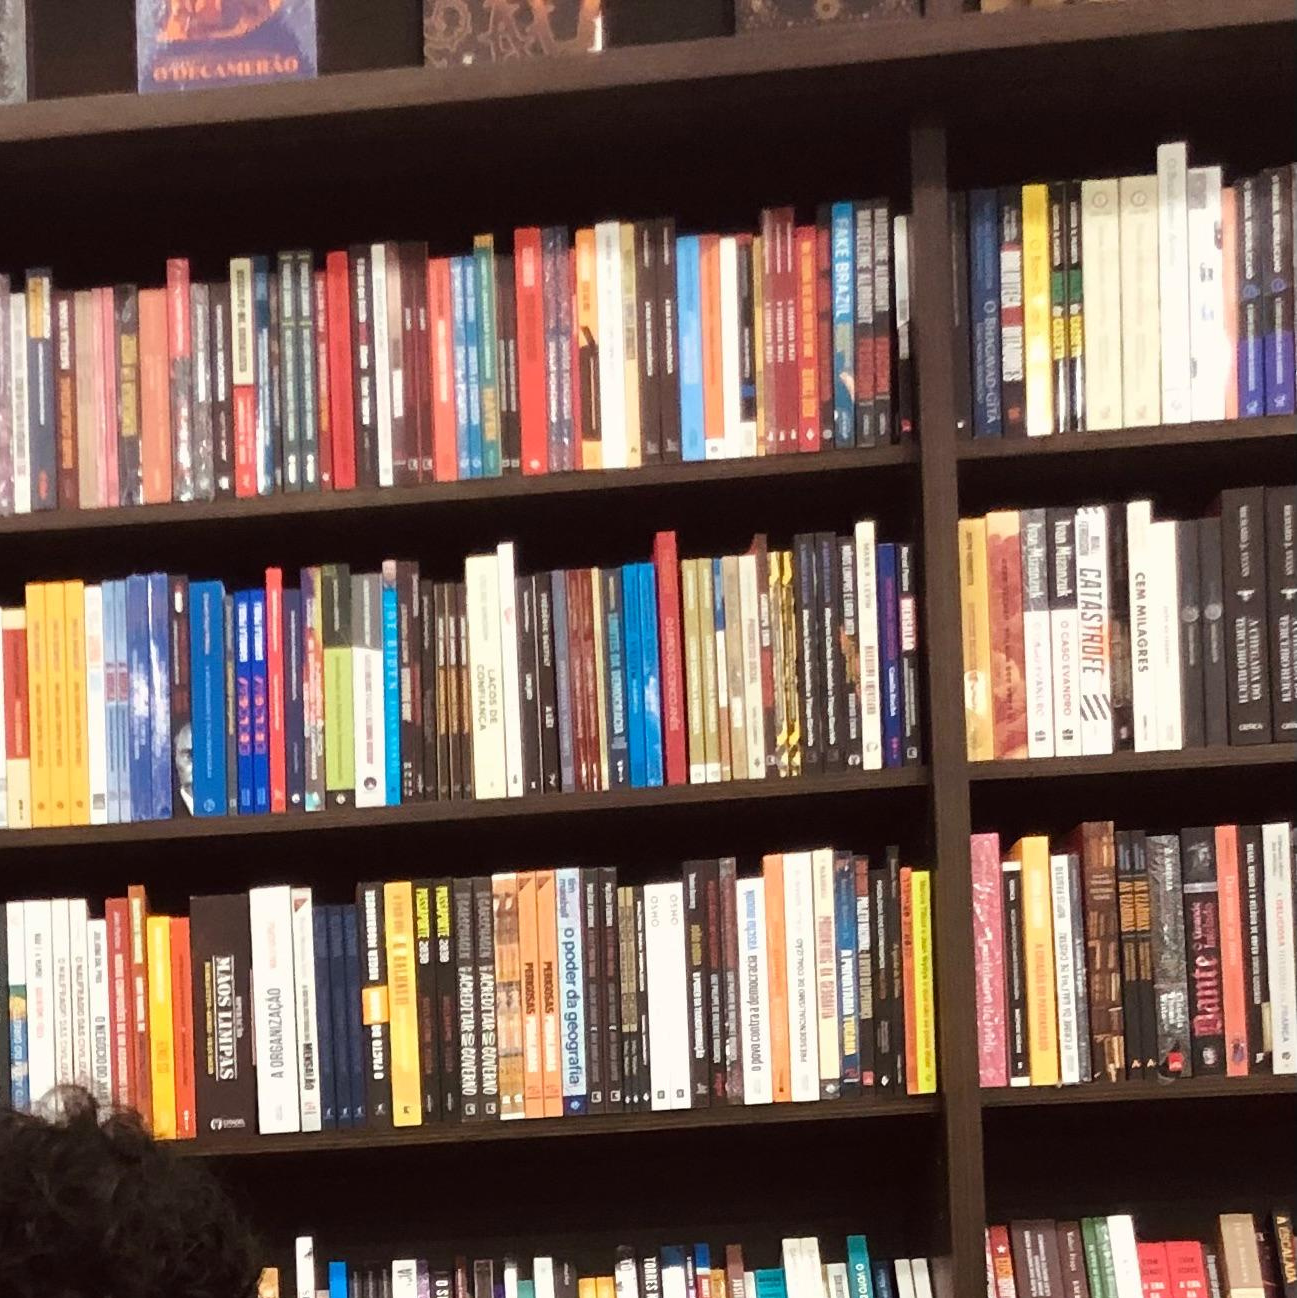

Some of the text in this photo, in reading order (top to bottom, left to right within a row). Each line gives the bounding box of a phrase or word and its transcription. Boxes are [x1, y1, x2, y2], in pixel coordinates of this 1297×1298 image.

[835, 217, 852, 318] FAKE BRAZIL
[1055, 520, 1070, 543] Ivan
[1079, 568, 1105, 674] CATÁSTROFE
[1135, 573, 1148, 673] CEM MILAGRES
[1061, 631, 1072, 716] CASO EVANDRO
[266, 988, 285, 1067] ORGANIZAÇÃO
[525, 963, 534, 1014] PERIGOSAS
[543, 961, 553, 1013] PERIGOSAS
[562, 927, 583, 1085] o poder da geografia
[218, 1011, 235, 1080] LIMPAS
[460, 974, 477, 1096] ACREDITAR GOVERNO
[479, 973, 497, 1095] ACREDITAR GOVERNO
[643, 1257, 659, 1291] TORRES
[1279, 1226, 1297, 1283] ESCALADA
